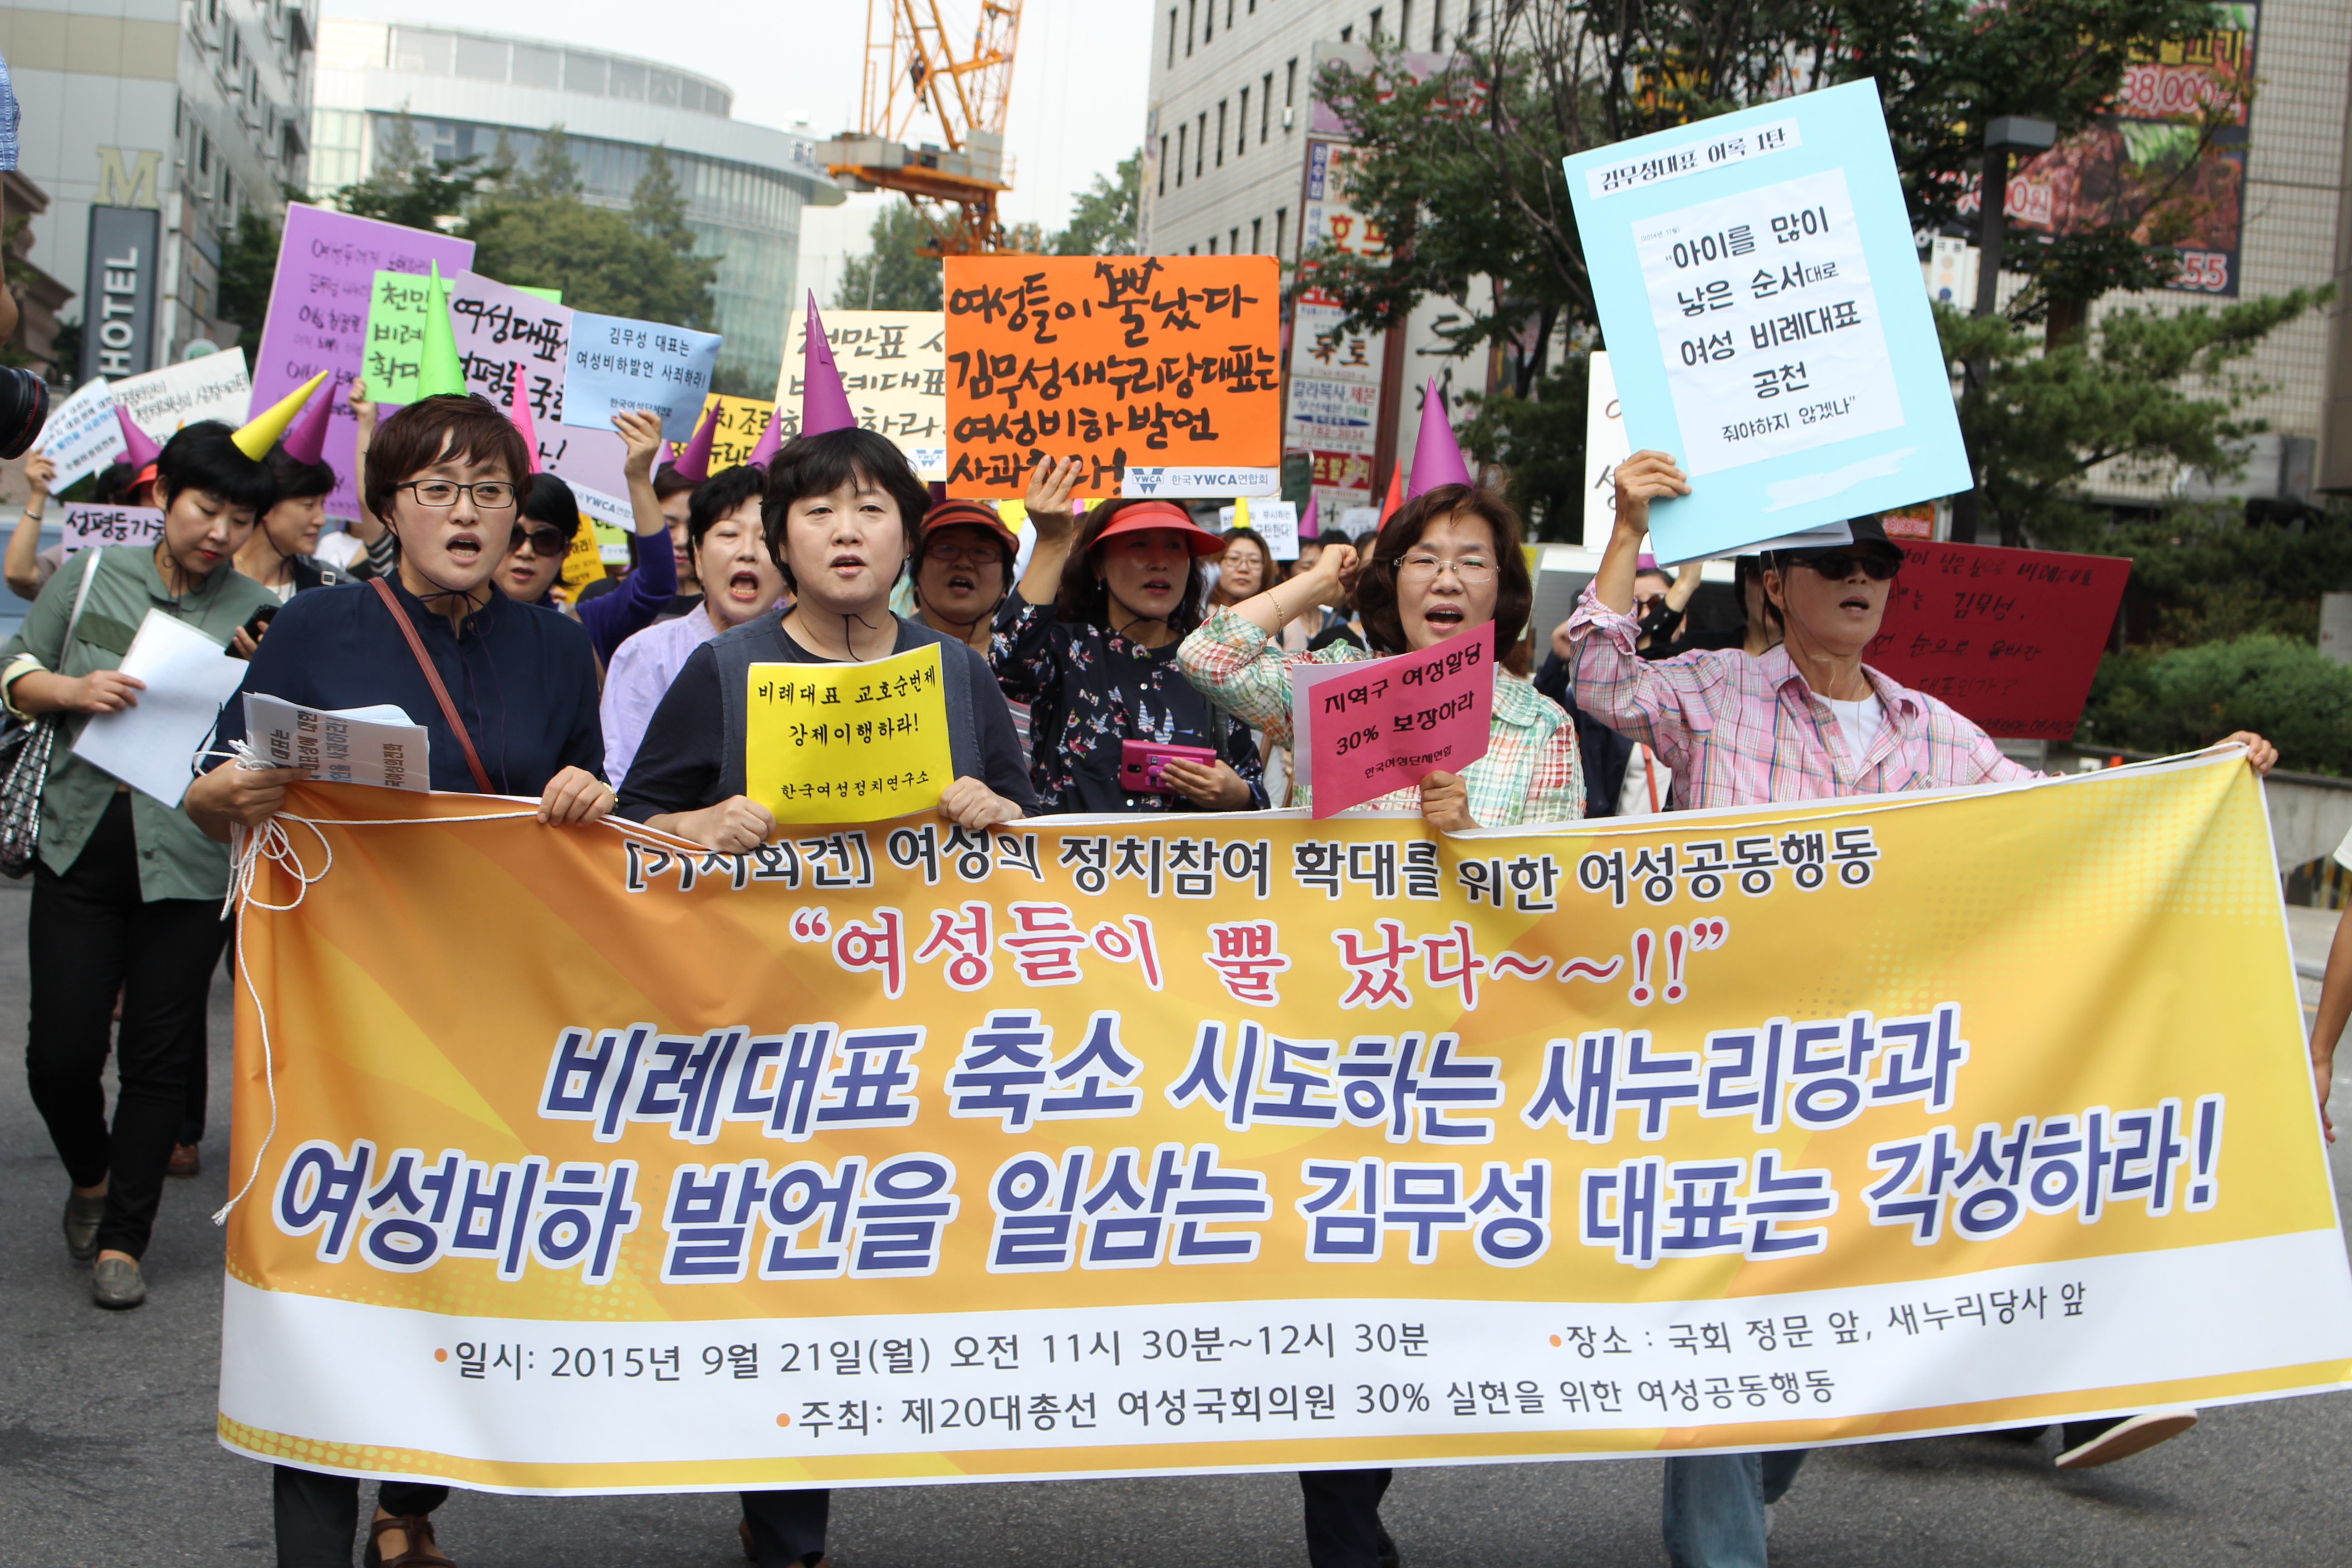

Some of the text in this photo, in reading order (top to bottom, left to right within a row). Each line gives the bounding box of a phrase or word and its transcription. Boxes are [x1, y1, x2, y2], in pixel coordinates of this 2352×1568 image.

[1600, 127, 1787, 191] 김무성대표 어록 1탄
[1771, 206, 1829, 244] 많이
[99, 246, 139, 376] HOTEL
[949, 273, 1091, 344] 여성들이
[1677, 261, 1839, 316] 낳은 순서대로
[609, 327, 690, 358] 김무성 대표는
[1681, 301, 1861, 366] 여성 비례대표
[577, 351, 706, 389] 여성비하발언 사죄하라!
[1753, 362, 1810, 399] 공천
[1722, 413, 1789, 442] 줘야하지
[759, 665, 936, 707] 비례대표 교호순번제
[1325, 642, 1482, 714] 지역구 여성할당
[297, 710, 318, 733] 대한
[789, 713, 918, 747] 강제이행하라!
[1337, 691, 1474, 755] 30% 보장하라
[781, 771, 929, 799] 한국여성정치연구소
[1365, 745, 1452, 779] 한국여성단체연합
[888, 825, 1044, 884] 여성의
[1060, 836, 1270, 898] 정치참여
[1293, 841, 1440, 900] 확대를
[1459, 856, 1559, 912] 위한
[1579, 826, 1879, 906] 여성공동행동
[1207, 923, 1288, 1004] 뿔
[544, 1007, 1965, 1139] 비례대표 축소 시도하는 새누리당과
[279, 1098, 2220, 1279] 여성비하 발언을 일삼는 김무성 대표는 각성하라!
[1667, 1321, 1732, 1356] 국회
[1747, 1314, 1813, 1352] 정문
[1828, 1309, 1872, 1345] 앞,
[1887, 1286, 2048, 1337] 새누리당사
[2060, 1281, 2087, 1318] 앞
[455, 1322, 1430, 1382] 일시: 2015년 9월 21일(월) 오전 11시 30분~12시 30분
[799, 1369, 1836, 1438] 주최: 제20대총선 여성국회의원 30% 실현을 위한 여성공동행동
